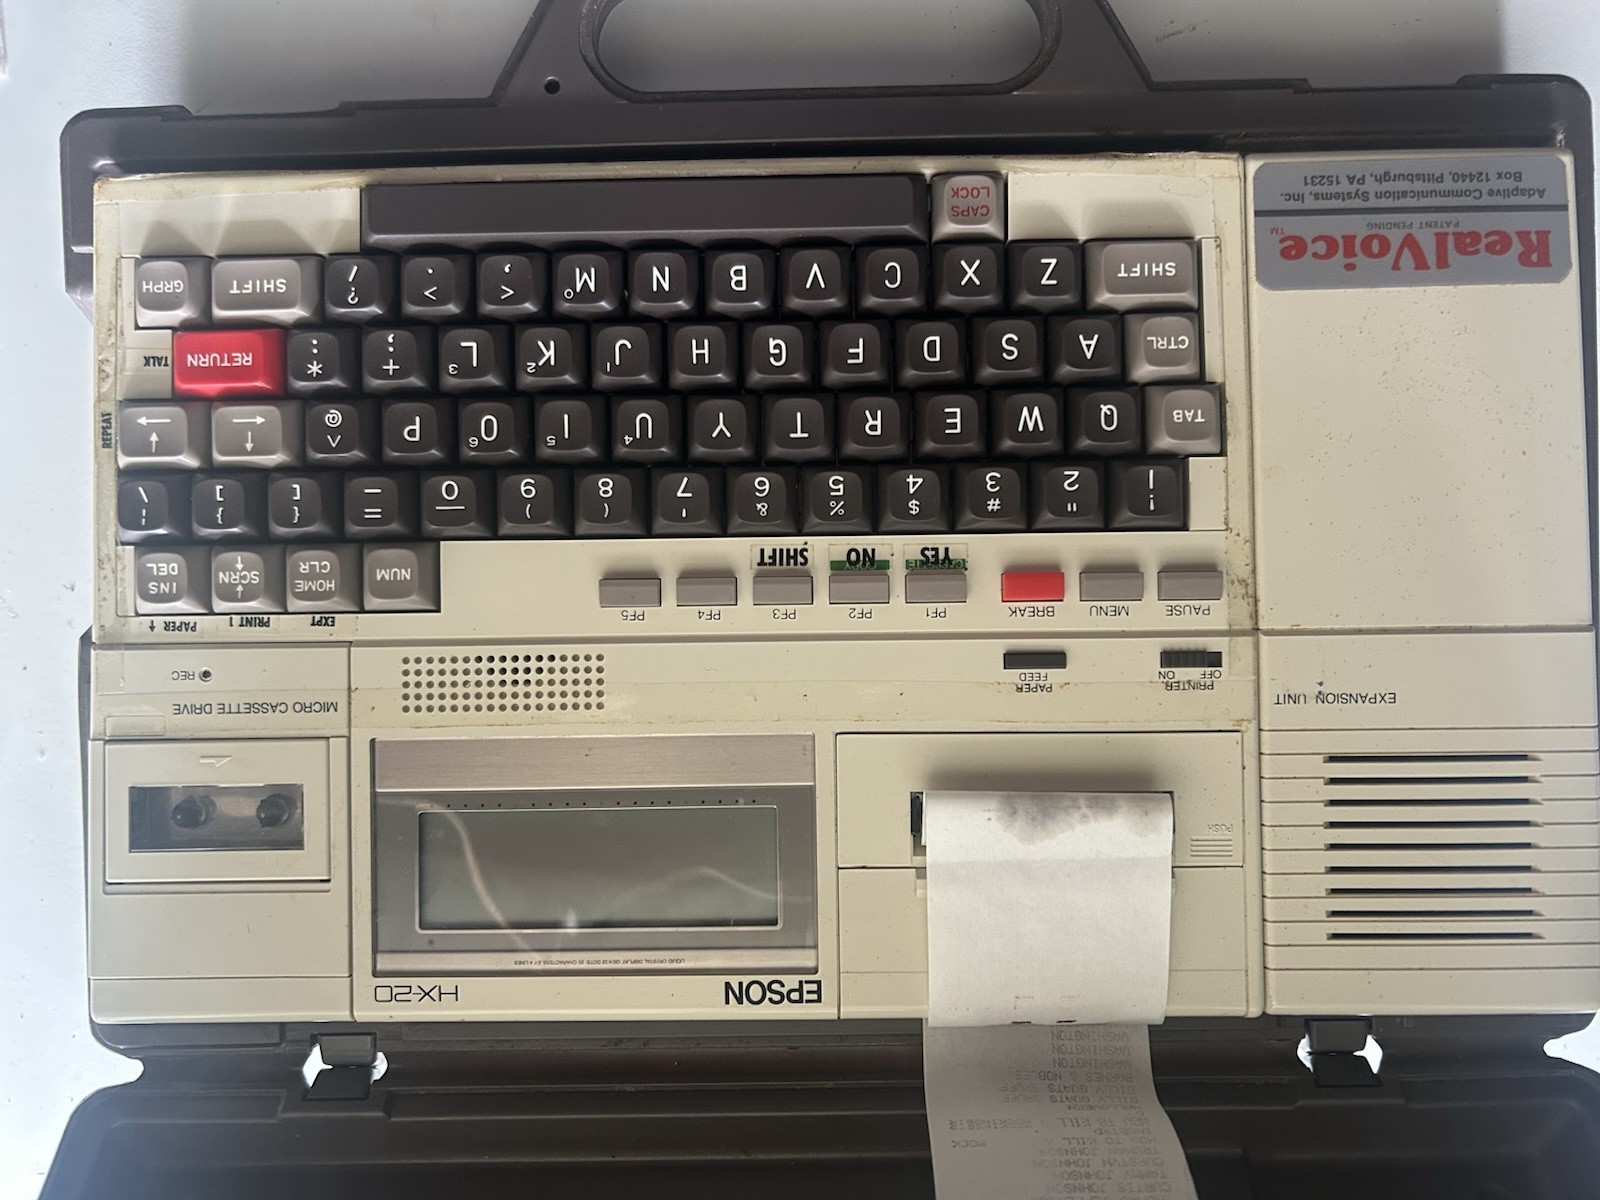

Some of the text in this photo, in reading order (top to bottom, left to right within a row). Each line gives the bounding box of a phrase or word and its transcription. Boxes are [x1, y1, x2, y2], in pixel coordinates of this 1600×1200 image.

[1303, 170, 1522, 186] Box 12440, Pittsburgh, PA 15231
[950, 186, 990, 199] LOCK
[1280, 186, 1546, 204] Adaptive Communication Systems, Inc.
[950, 205, 990, 218] CAPS
[1366, 220, 1460, 230] PATENT PENDING
[1278, 230, 1552, 272] RealVoice
[652, 265, 670, 292] N
[729, 264, 747, 292] B
[805, 262, 825, 289] V
[884, 262, 902, 288] C
[960, 259, 981, 286] X
[1040, 258, 1058, 285] Z
[1116, 262, 1176, 278] SHIFT
[142, 279, 184, 292] GRPH
[229, 278, 287, 294] SHIFT
[575, 267, 596, 293] M
[348, 286, 359, 304] ?
[691, 338, 709, 364] H
[846, 338, 864, 364] F
[922, 335, 941, 362] D
[1000, 332, 1019, 360] S
[1078, 334, 1099, 360] A
[1146, 335, 1190, 350] CTRL
[186, 352, 253, 368] RETURN
[460, 342, 478, 368] L
[537, 340, 555, 367] K
[614, 339, 632, 366] J
[768, 337, 787, 366] G
[143, 355, 169, 368] TALK
[324, 409, 342, 428] @
[864, 409, 882, 436] R
[944, 407, 962, 434] E
[1017, 404, 1044, 432] W
[1100, 404, 1118, 432] Q
[1172, 409, 1205, 422] TAB
[101, 412, 113, 449] REPEAT
[403, 415, 422, 442] P
[635, 412, 652, 440] U
[711, 412, 732, 438] Y
[788, 411, 809, 438] T
[520, 478, 536, 498] 9
[598, 478, 614, 498] 8
[676, 476, 693, 498] 7
[753, 476, 770, 497] 6
[828, 475, 844, 496] 5
[906, 474, 924, 494] 4
[985, 471, 1001, 492] 3
[1063, 470, 1080, 491] 2
[441, 480, 459, 500] 0
[755, 502, 768, 517] &
[829, 500, 845, 516] %
[908, 499, 920, 516] $
[986, 498, 1001, 512] #
[1148, 494, 1155, 511] !
[756, 548, 809, 567] SHIFT
[846, 548, 876, 566] NO
[920, 546, 950, 566] YES
[146, 562, 179, 576] DEL
[299, 560, 331, 574] CLR
[376, 568, 411, 581] NUM
[218, 570, 260, 584] SCRN
[294, 579, 336, 592] HOME
[148, 581, 177, 594] INS
[620, 610, 645, 621] PF5
[697, 610, 721, 620] PF4
[772, 609, 796, 620] PF3
[848, 608, 872, 619] PF2
[925, 607, 946, 618] PF1
[1008, 606, 1055, 617] BREAK
[1089, 605, 1130, 616] MENU
[1165, 604, 1210, 616] PAUSE
[163, 620, 197, 632] PAPER
[238, 616, 270, 628] PRINT
[310, 616, 336, 627] EXPT
[171, 670, 196, 680] REC
[1018, 672, 1048, 682] FEED
[1158, 670, 1175, 680] ON
[1200, 670, 1222, 679] OFF
[1016, 683, 1052, 692] PAPER
[1165, 681, 1214, 690] PRINTER
[1274, 692, 1396, 705] EXPANSION UNIT
[172, 702, 338, 715] MICRO CASSETTE DRIVE
[1206, 824, 1234, 834] PUSH
[374, 984, 459, 1002] HX-20
[724, 980, 822, 1006] EPSON
[1050, 1030, 1130, 1042] WASHINGTON
[1051, 1044, 1130, 1055] WASHINGTON
[1052, 1057, 1132, 1068] WASHINGTON
